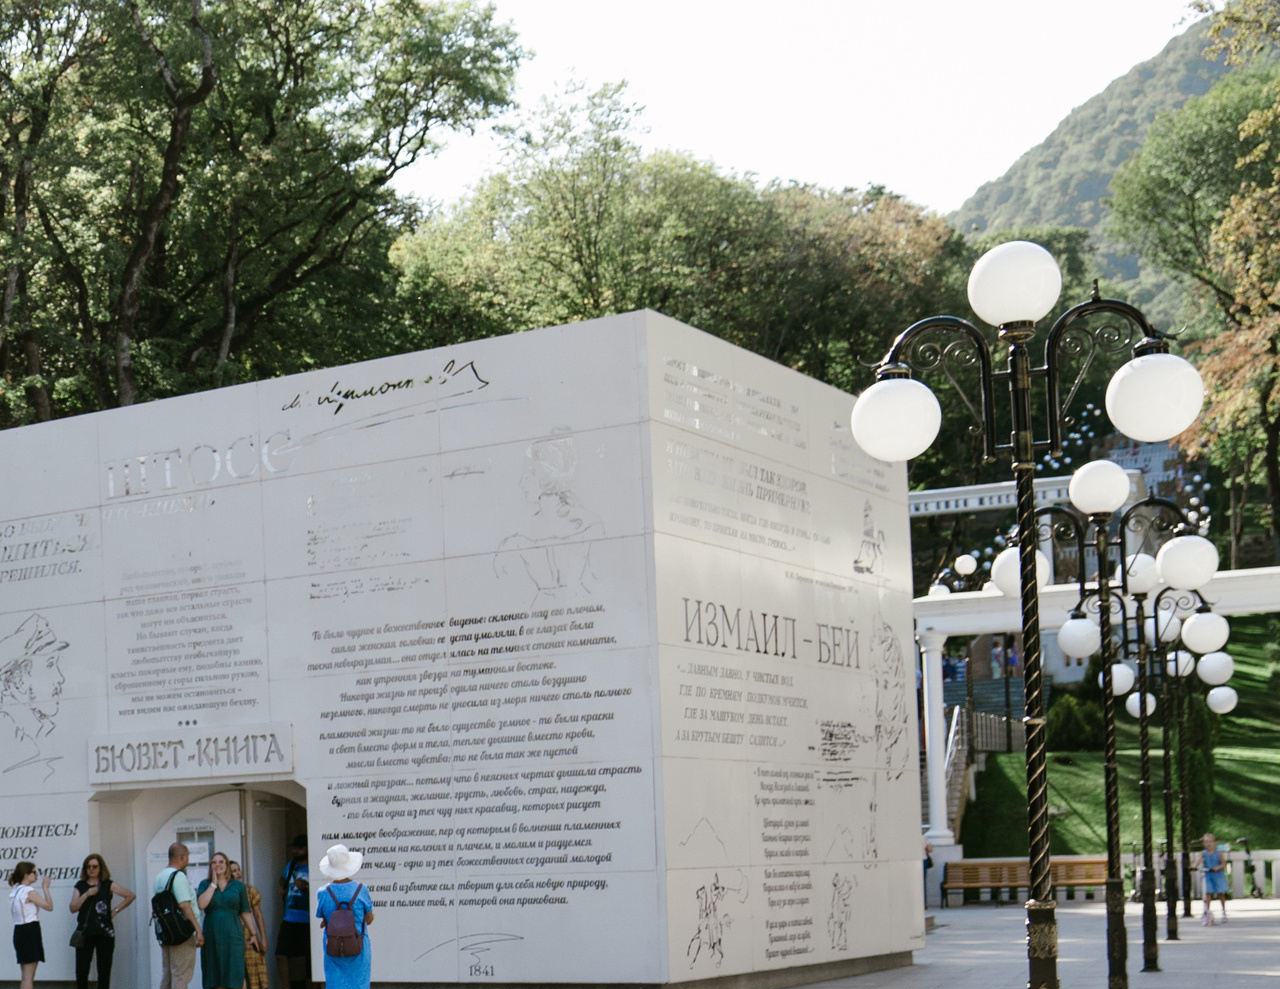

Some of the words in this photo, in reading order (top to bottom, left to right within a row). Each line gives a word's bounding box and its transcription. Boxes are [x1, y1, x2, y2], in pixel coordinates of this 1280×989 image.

[312, 630, 321, 640] То
[323, 629, 344, 639] было
[346, 627, 374, 639] чудное
[383, 620, 445, 633] божественное
[488, 612, 529, 623] склонясь
[531, 609, 548, 620] над
[550, 608, 564, 616] его
[682, 597, 796, 659] ИЗМАИЛ
[816, 617, 860, 669] БЕЙ
[330, 644, 356, 654] сияла
[358, 641, 396, 651] женская
[449, 633, 472, 645] уста
[525, 627, 534, 635] ее
[536, 623, 567, 635] глазах
[569, 620, 593, 630] была
[355, 677, 372, 685] как
[373, 673, 417, 687] утренняя
[418, 670, 448, 683] звезда
[450, 669, 461, 677] на
[463, 665, 514, 678] туманном
[367, 705, 401, 716] никогда
[403, 703, 437, 714] смерть
[451, 699, 488, 711] уносила
[490, 698, 501, 708] из
[502, 696, 527, 706] моря
[529, 693, 560, 702] ничего
[562, 691, 592, 700] столь
[594, 687, 631, 697] полного
[679, 684, 692, 696] ГДЕ
[684, 707, 697, 719] ГДЕ
[319, 728, 366, 740] пламенной
[401, 726, 414, 734] то
[416, 725, 426, 733] не
[427, 722, 449, 732] было
[451, 718, 496, 733] существо
[498, 718, 530, 730] земное
[554, 713, 578, 723] были
[580, 712, 614, 724] краски
[335, 744, 355, 754] свет
[356, 742, 389, 753] вместо
[391, 741, 416, 753] форм
[452, 737, 485, 746] теплое
[487, 734, 525, 747] дыхание
[527, 731, 563, 741] вместо
[345, 760, 374, 768] мысли
[376, 757, 409, 766] вместо
[452, 754, 466, 762] то
[467, 753, 478, 761] не
[479, 750, 503, 760] была
[504, 750, 525, 759] так
[526, 749, 541, 757] же
[543, 745, 578, 759] пустой
[334, 779, 369, 789] ложный
[415, 776, 451, 786] потому
[453, 775, 472, 783] что
[480, 772, 518, 781] неясных
[520, 770, 554, 782] чертах
[556, 768, 596, 780] дышала
[598, 766, 642, 777] страсть
[331, 795, 361, 807] бурная
[367, 846, 396, 855] стоим
[410, 843, 446, 852] коленях
[502, 841, 536, 849] молим
[544, 839, 592, 850] радуемся
[396, 899, 425, 907] полнее
[458, 896, 497, 908] которой
[469, 965, 494, 976] 1841
